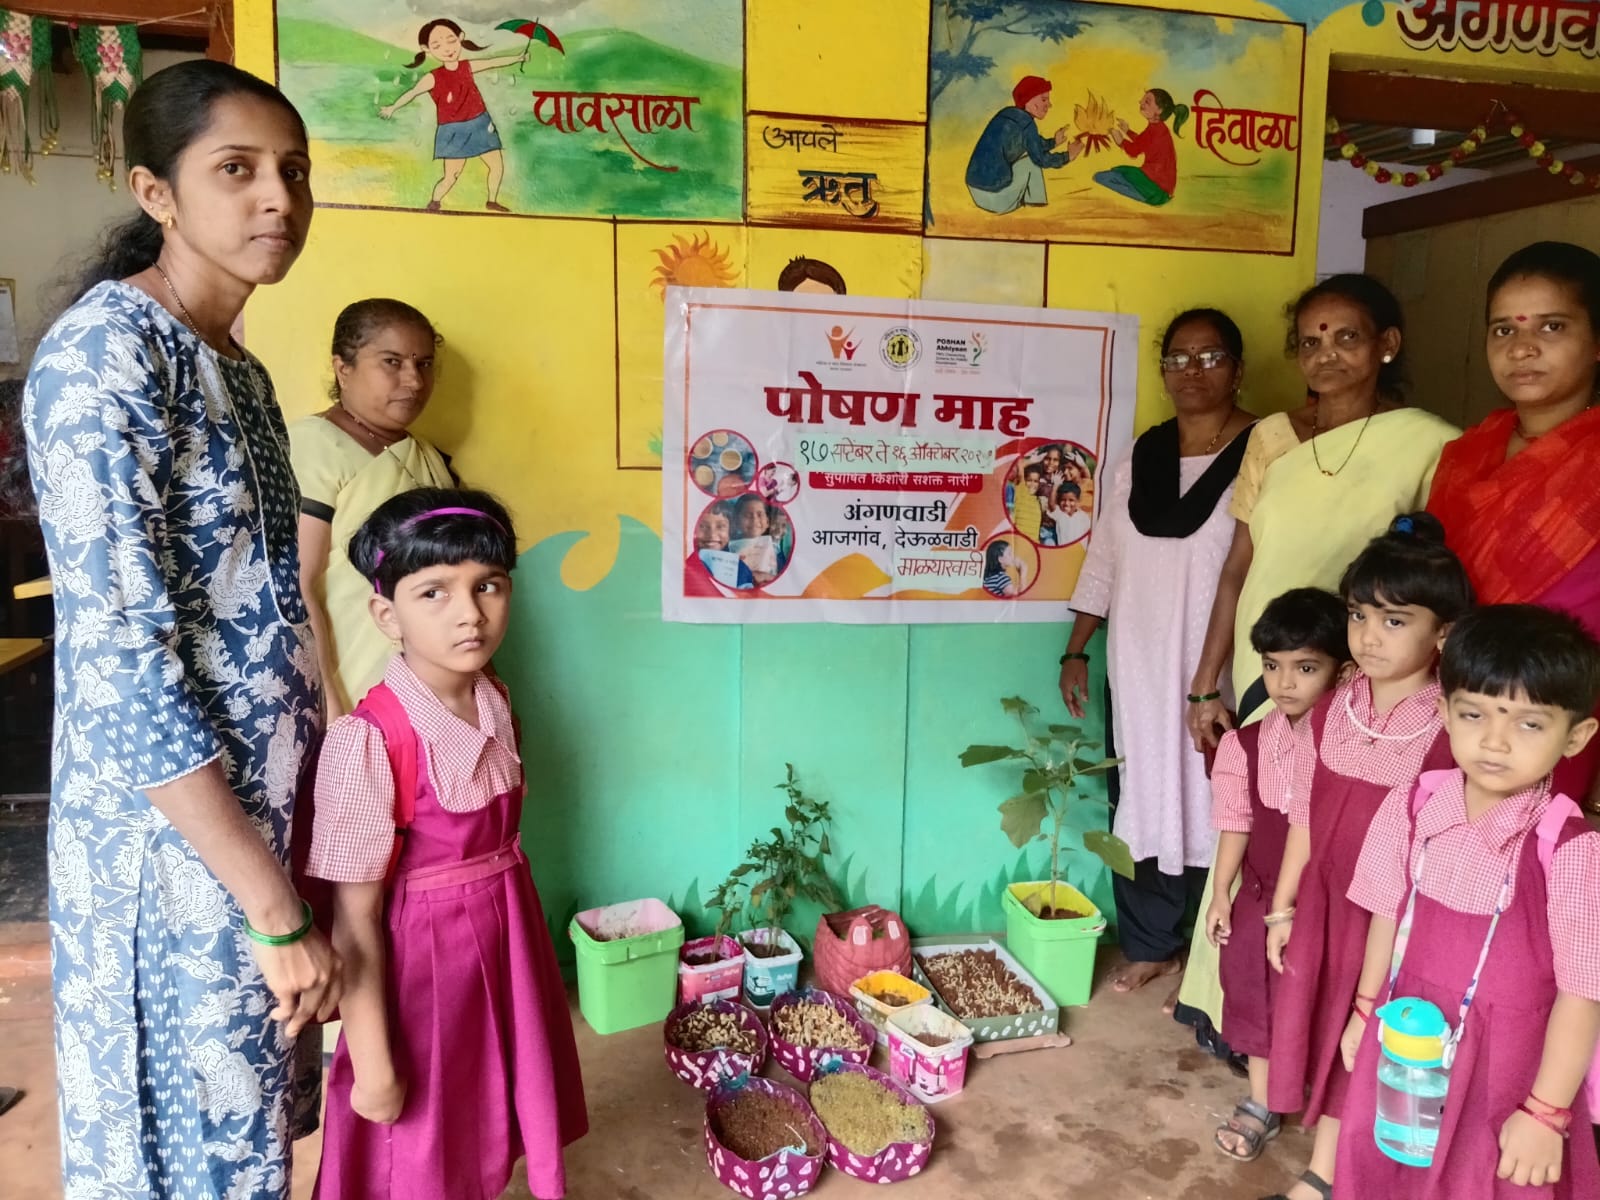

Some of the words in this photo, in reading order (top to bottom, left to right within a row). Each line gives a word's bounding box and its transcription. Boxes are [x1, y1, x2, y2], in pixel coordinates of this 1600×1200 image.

[532, 90, 701, 173] पावसाळा
[762, 124, 844, 153] आपले
[1190, 89, 1298, 166] हिवाळा
[798, 169, 880, 218] ऋतु
[936, 338, 966, 346] POSHAN
[764, 371, 921, 429] पोषण
[933, 394, 1034, 437] माह
[800, 439, 829, 465] १७
[876, 440, 891, 464] ते
[844, 499, 948, 522] अंगणवाडी
[812, 526, 887, 550] आजगांव,
[895, 526, 978, 549] देऊळवाडी
